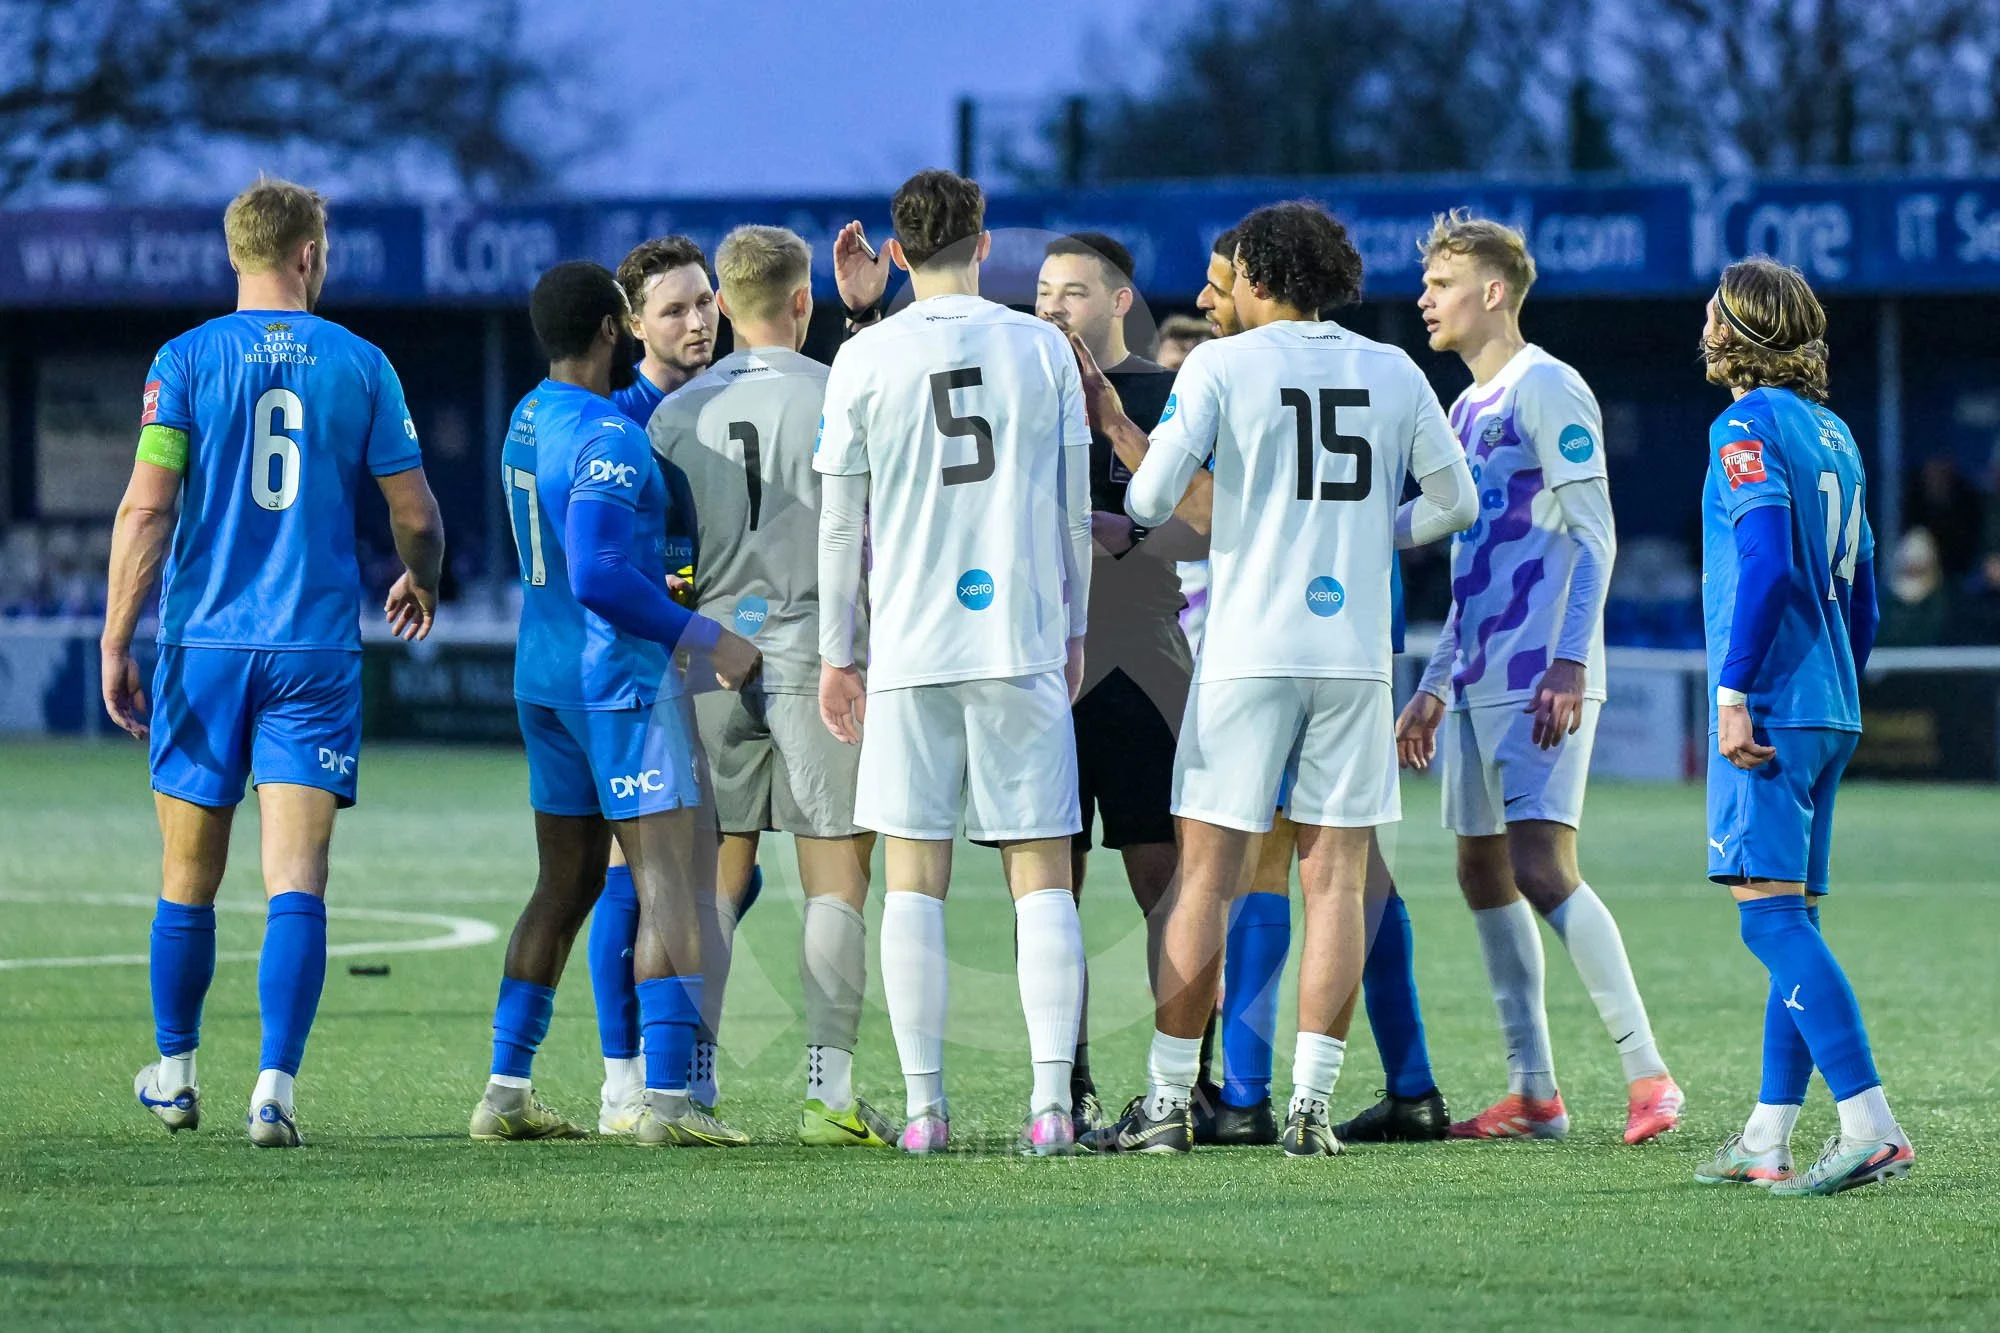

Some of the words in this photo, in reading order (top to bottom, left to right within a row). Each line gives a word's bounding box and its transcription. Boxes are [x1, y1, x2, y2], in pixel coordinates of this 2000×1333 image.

[253, 342, 307, 353] CROWN
[263, 332, 295, 342] THE
[244, 353, 318, 366] BILLERICAY
[929, 366, 996, 486] 5
[251, 388, 304, 511] 6
[1280, 388, 1372, 501] 15
[1561, 436, 1590, 452] xero
[589, 459, 637, 487] DMC
[728, 420, 762, 531] 1
[504, 464, 546, 586] 17
[1817, 471, 1862, 601] 14
[959, 583, 993, 597] xero
[1309, 590, 1342, 602] xero
[736, 608, 766, 623] xero
[318, 747, 356, 776] DMC
[609, 769, 665, 799] DMC
